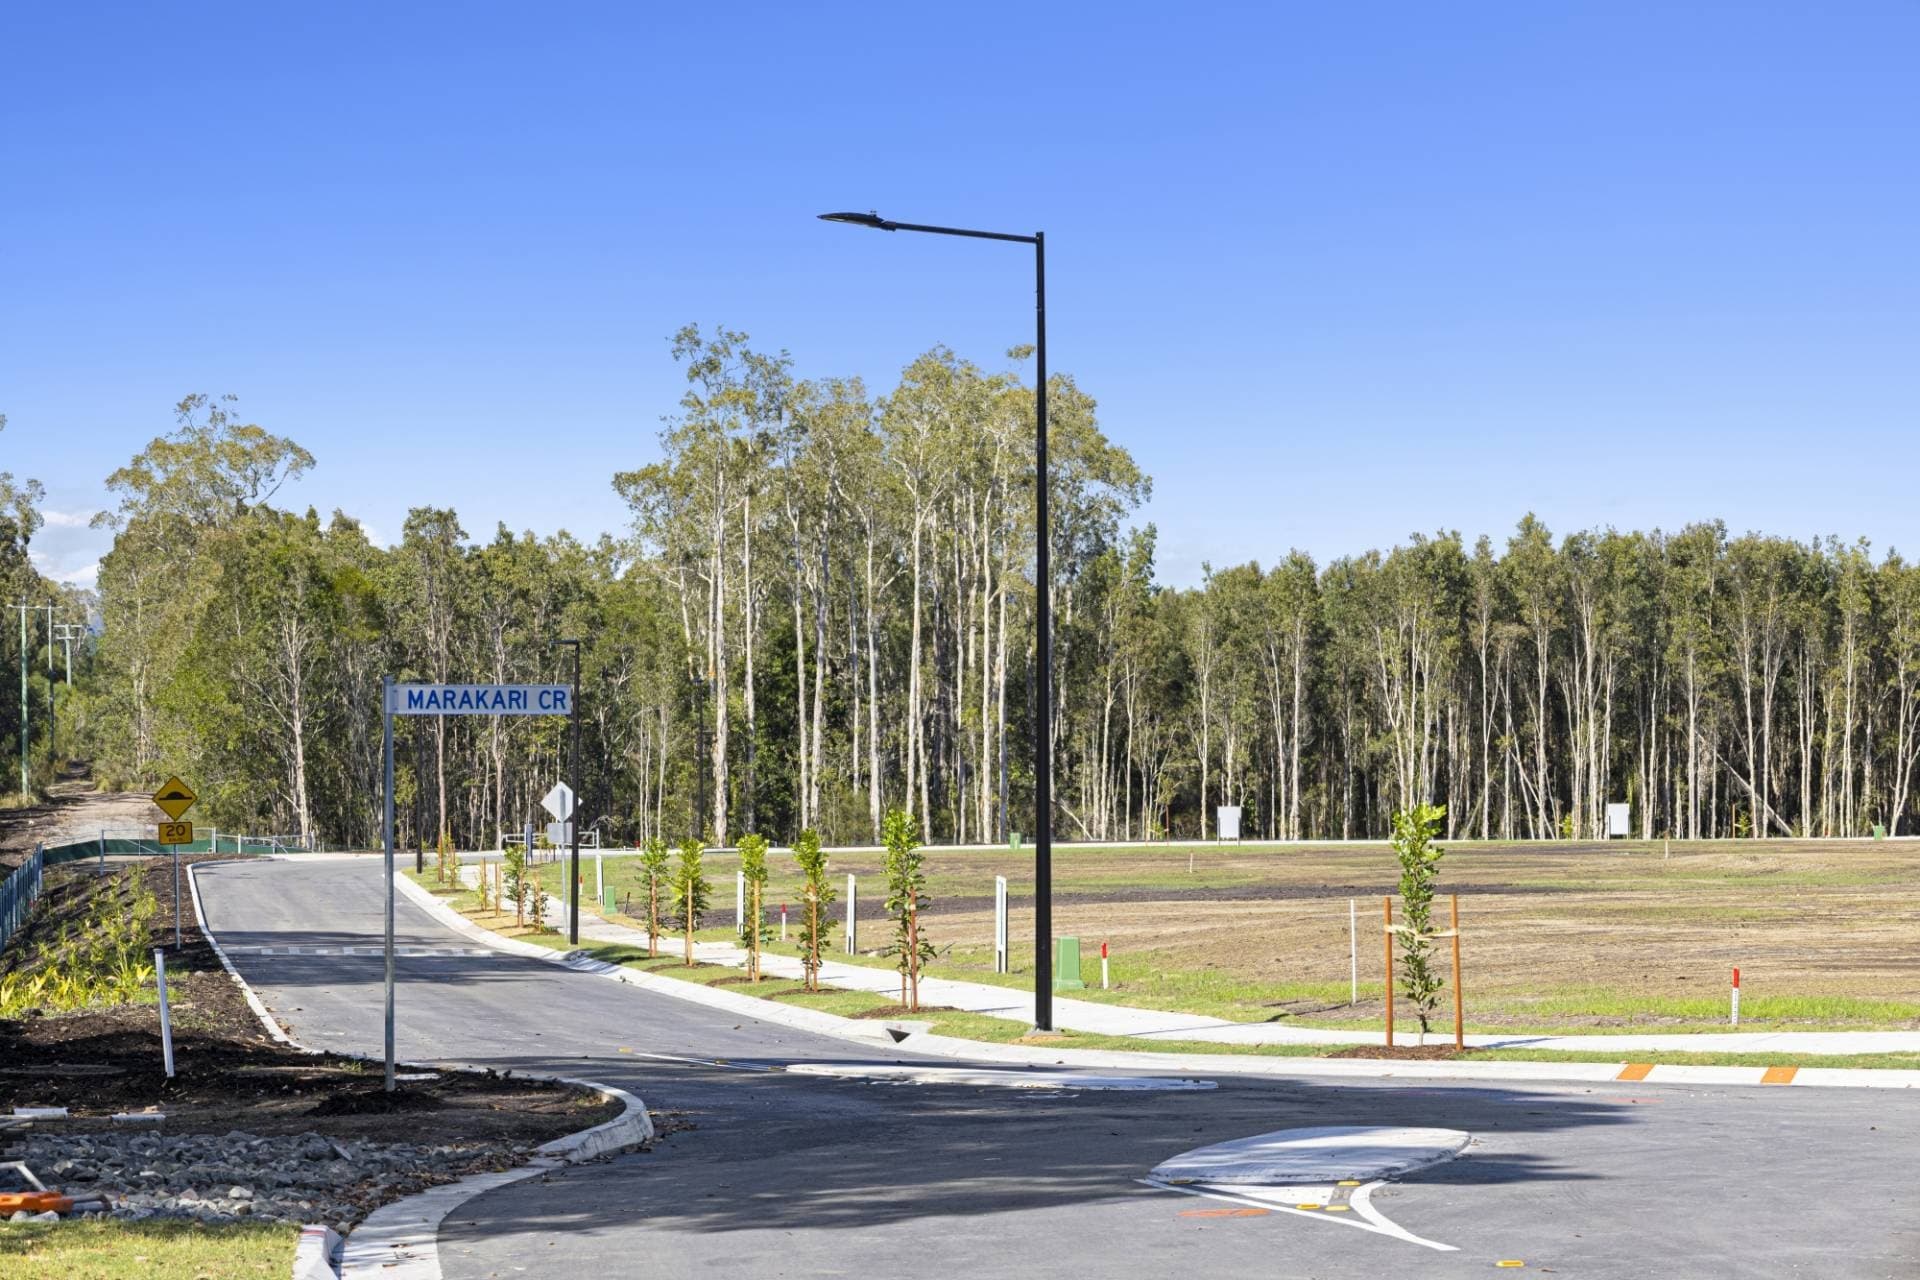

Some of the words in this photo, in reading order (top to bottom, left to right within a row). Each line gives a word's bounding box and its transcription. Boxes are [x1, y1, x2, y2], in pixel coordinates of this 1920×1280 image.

[407, 690, 528, 709] MARAKARI
[538, 690, 566, 709] CR
[166, 825, 185, 836] 20
